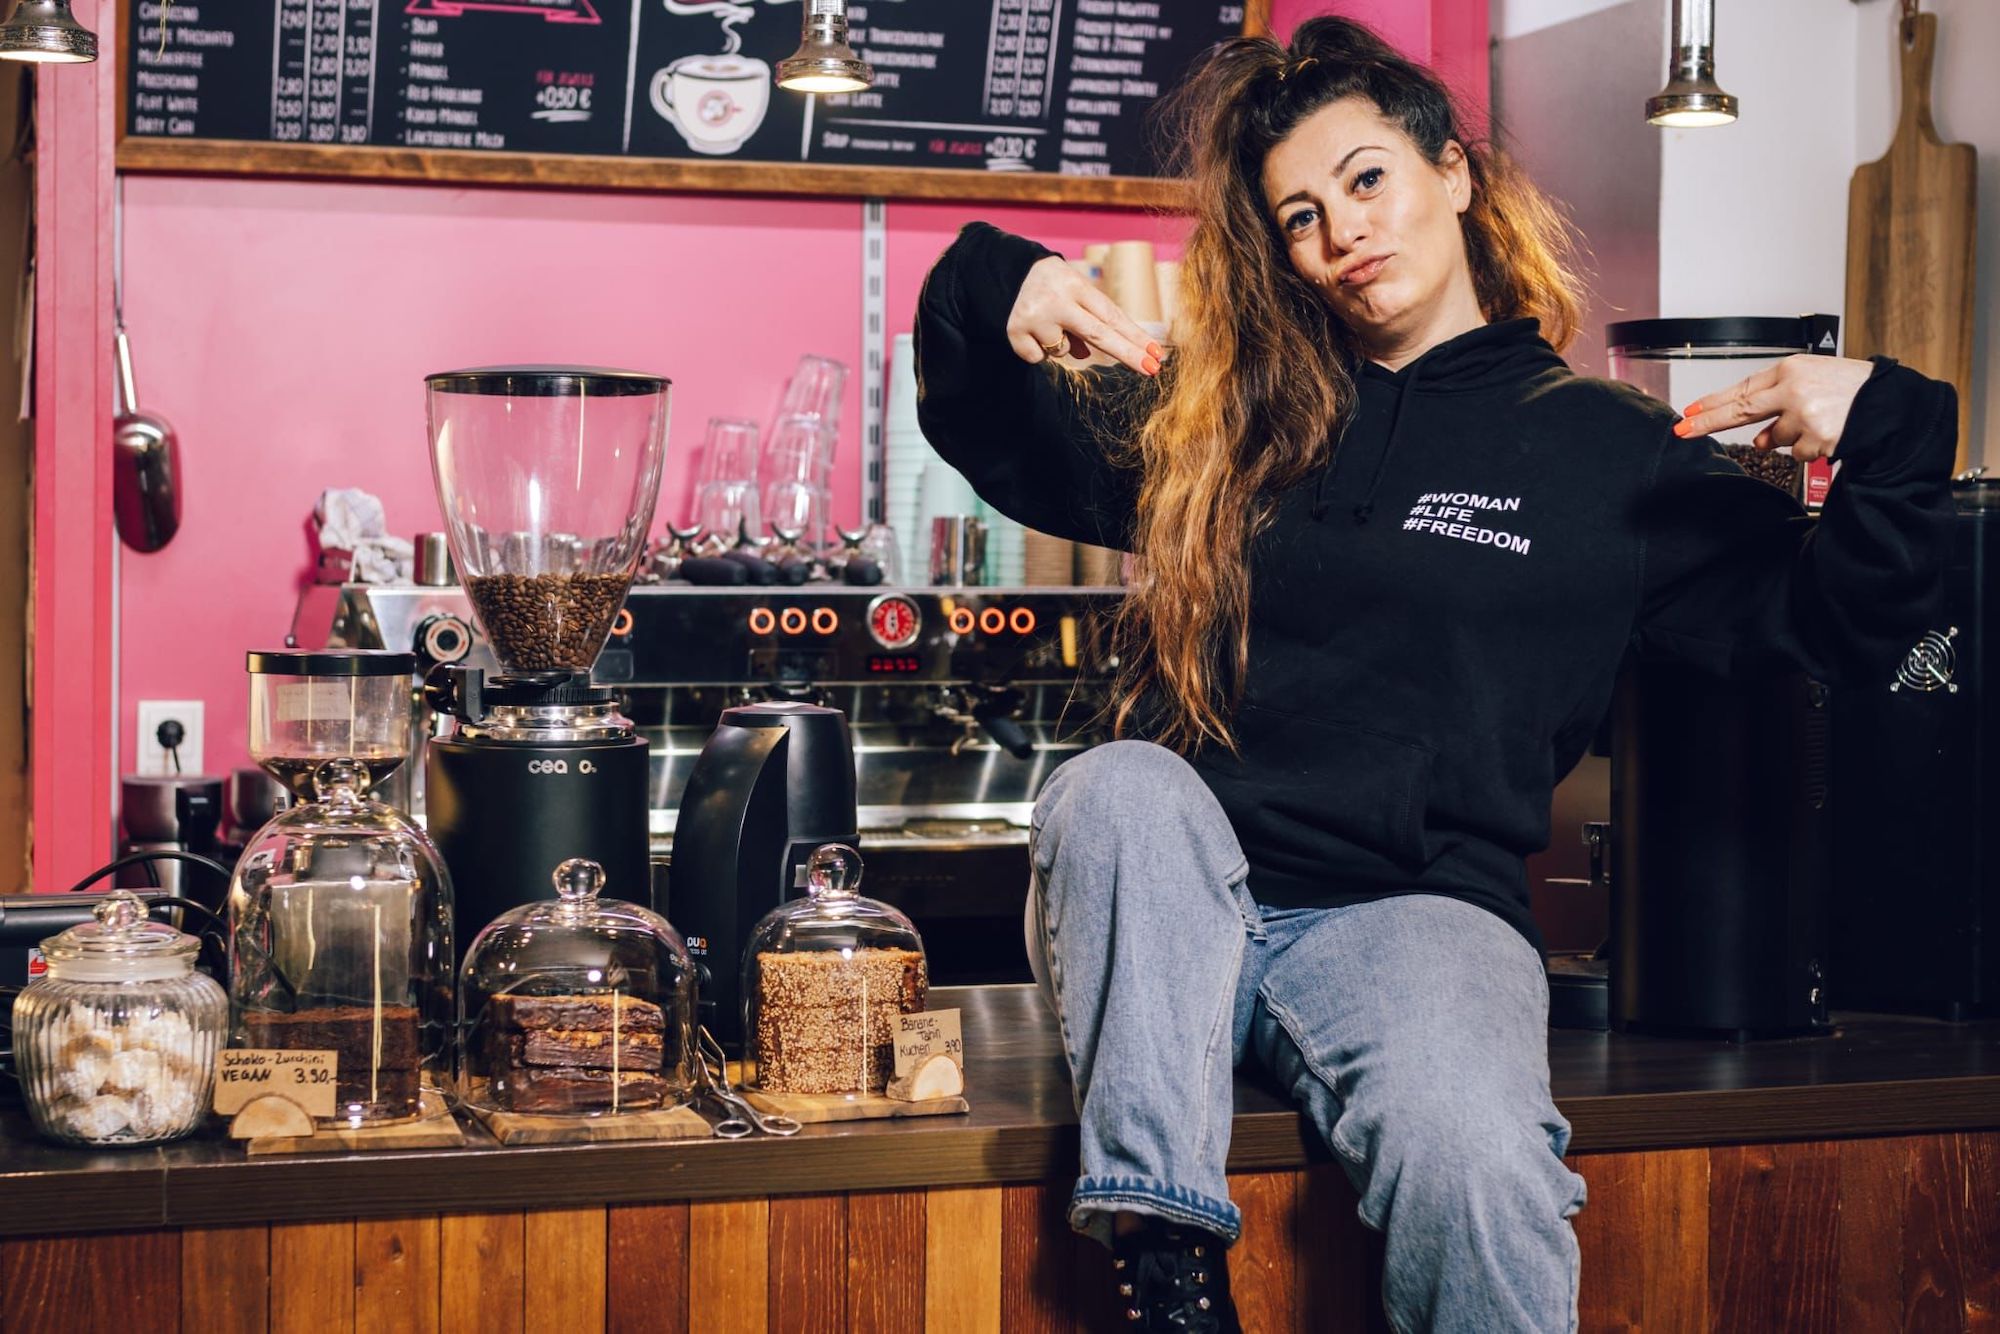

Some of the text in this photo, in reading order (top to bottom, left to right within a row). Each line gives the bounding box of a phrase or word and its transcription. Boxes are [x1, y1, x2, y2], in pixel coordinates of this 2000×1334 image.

[1417, 493, 1521, 511] #WOMAN
[1410, 505, 1474, 523] #LIFE
[1403, 517, 1531, 556] #FREEDOM
[900, 1043, 930, 1057] Kuchen
[221, 1068, 272, 1082] VEGAN
